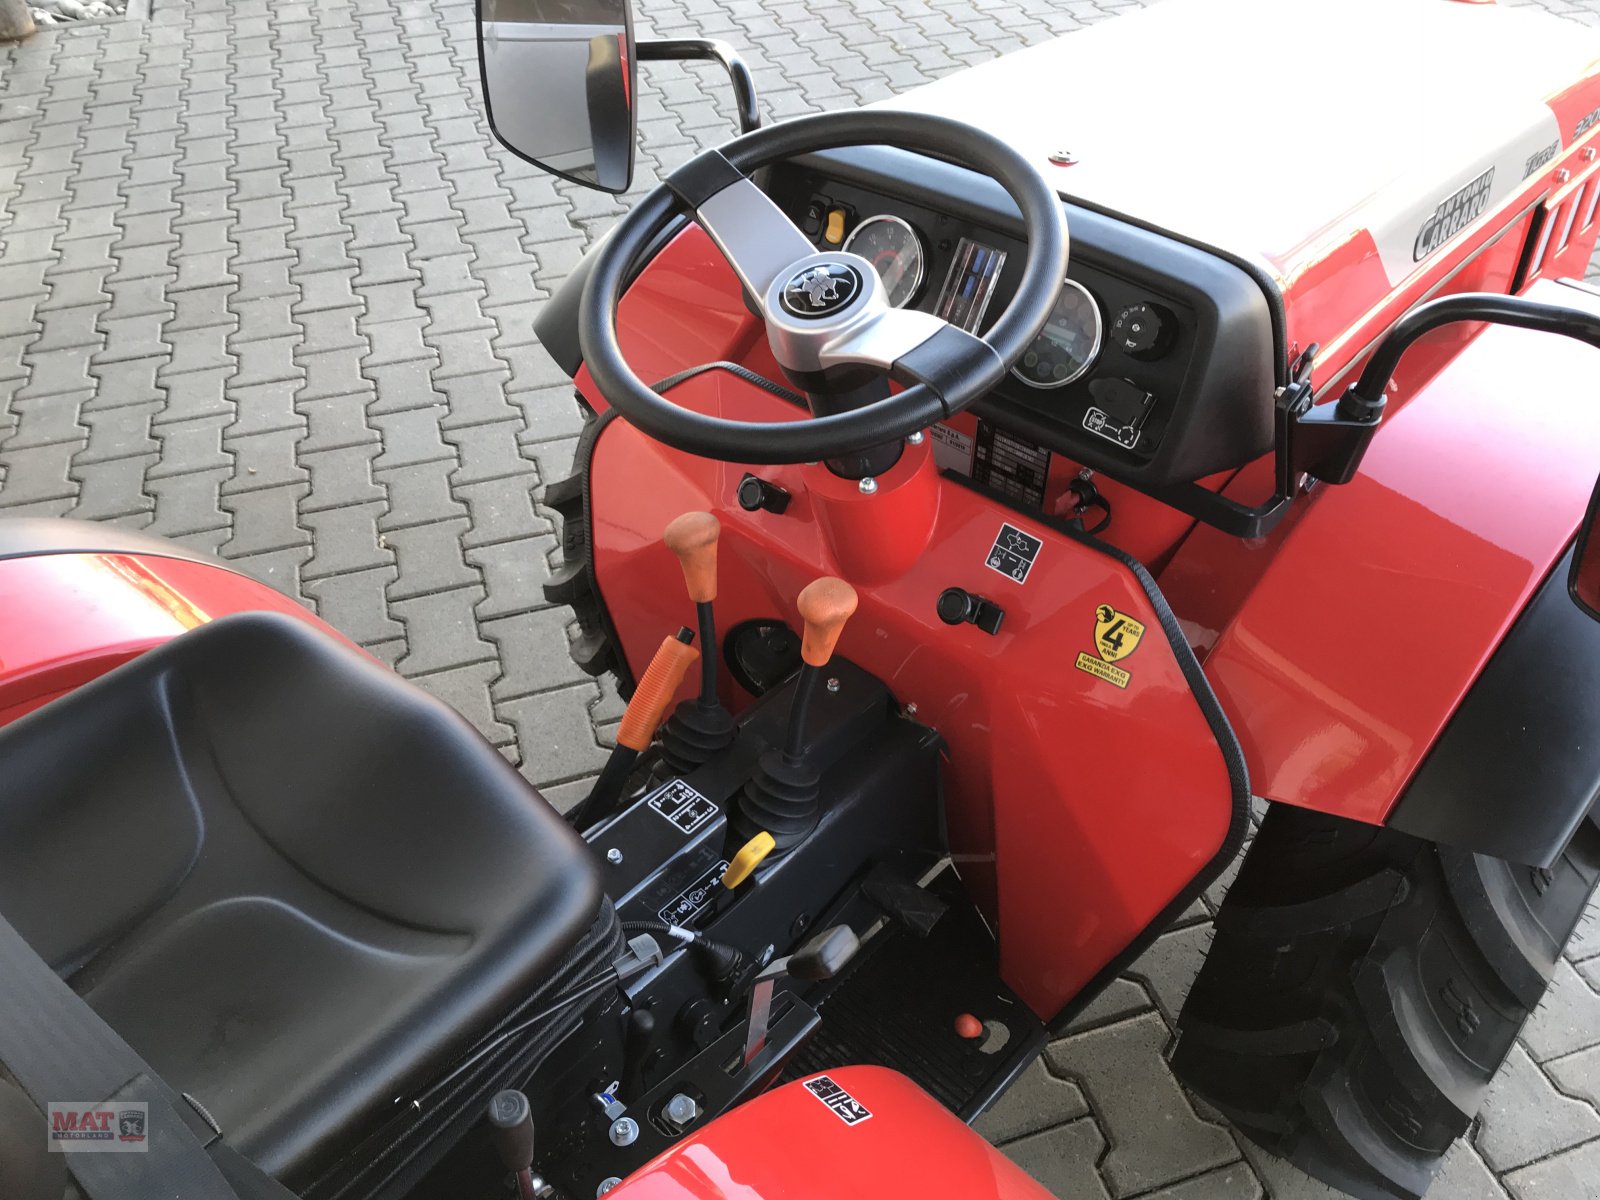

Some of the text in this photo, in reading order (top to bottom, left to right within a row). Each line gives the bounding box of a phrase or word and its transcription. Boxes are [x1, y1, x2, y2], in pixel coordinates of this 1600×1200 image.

[1435, 167, 1495, 222] ANTONIO
[1413, 188, 1491, 262] CARRARO
[1101, 619, 1126, 652] 4
[1122, 626, 1140, 637] YEARS
[1102, 647, 1118, 658] ANNI
[1082, 655, 1110, 671] GARANZIA
[1093, 666, 1125, 686] WARRANTY
